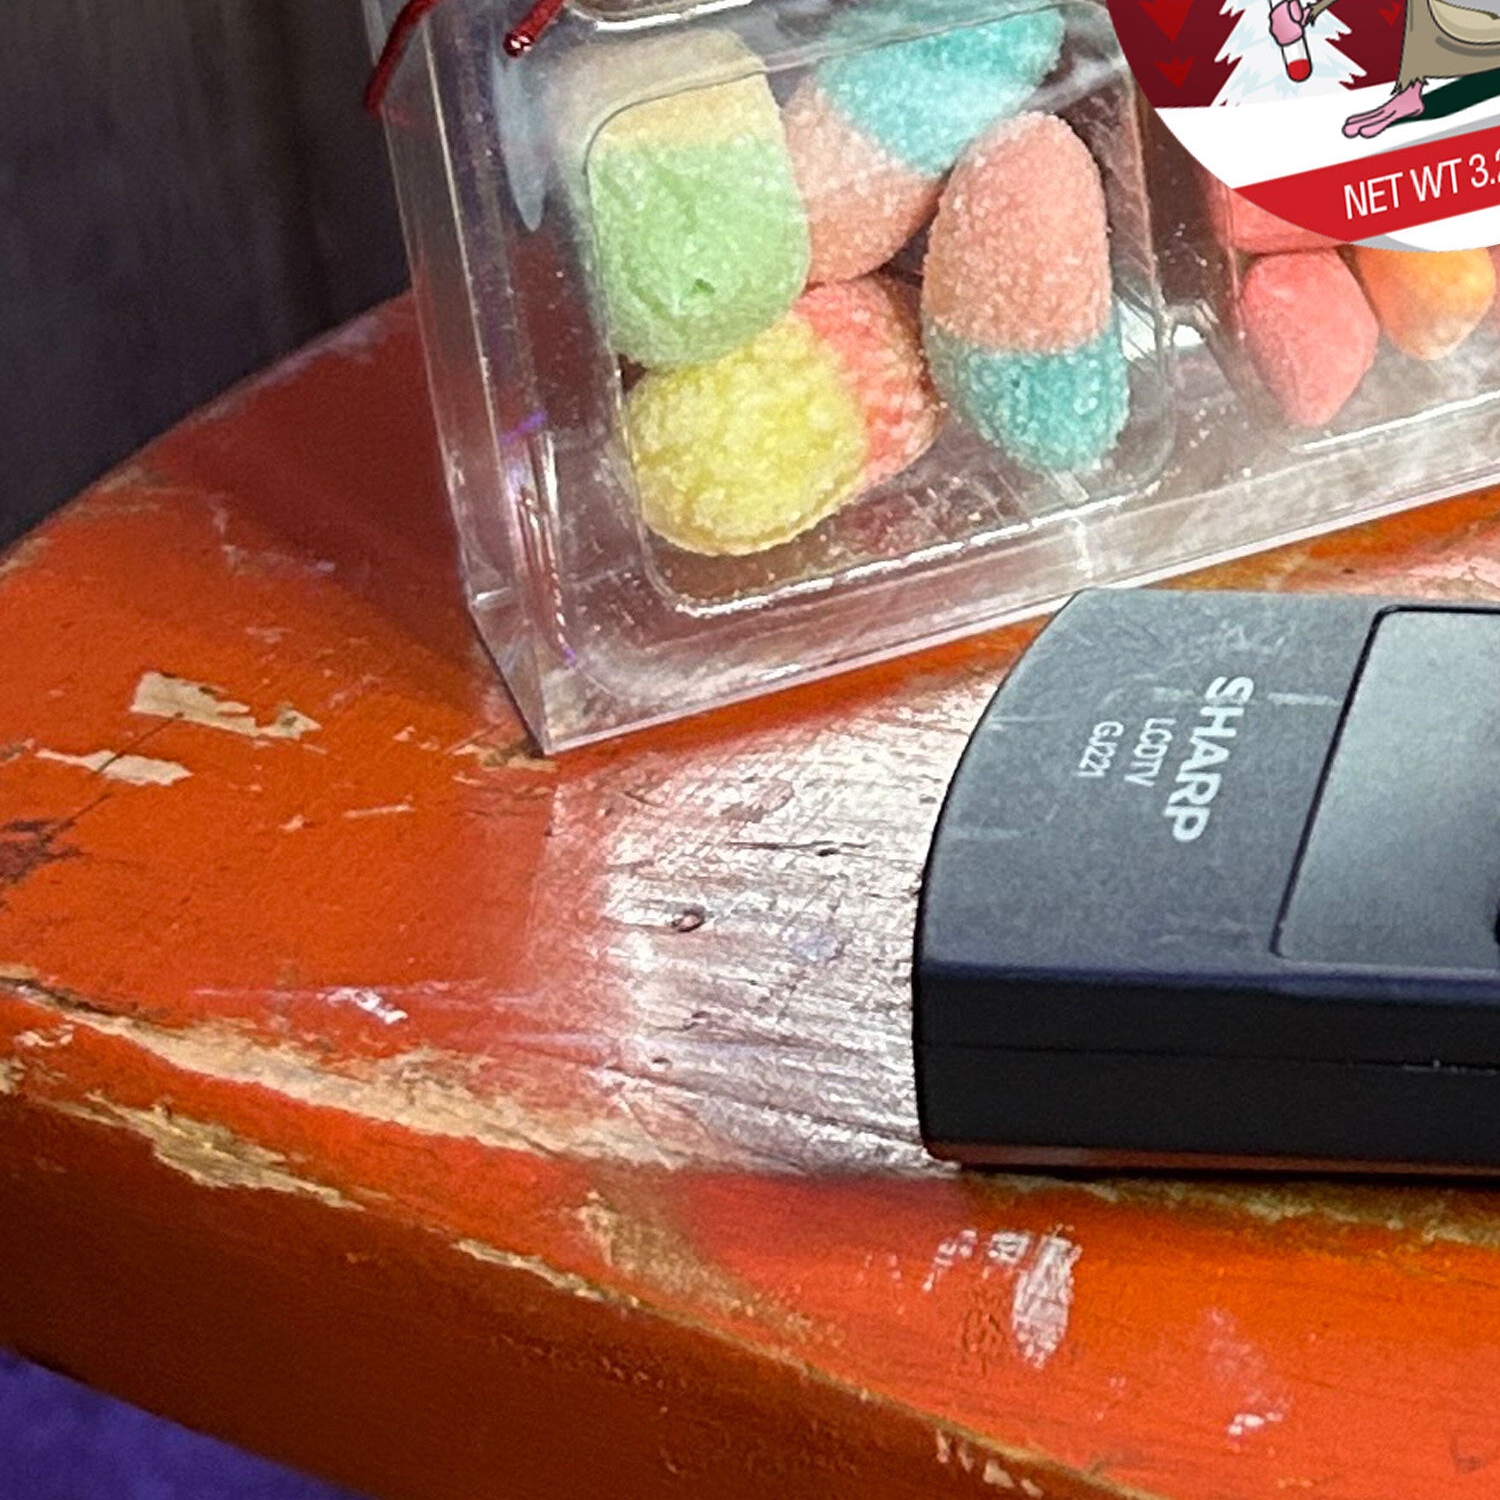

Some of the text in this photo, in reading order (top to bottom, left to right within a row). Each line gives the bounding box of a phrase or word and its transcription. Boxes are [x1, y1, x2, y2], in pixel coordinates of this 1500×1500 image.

[1344, 172, 1403, 220] NET
[1410, 159, 1462, 204] WT
[1163, 676, 1254, 841] SHARP
